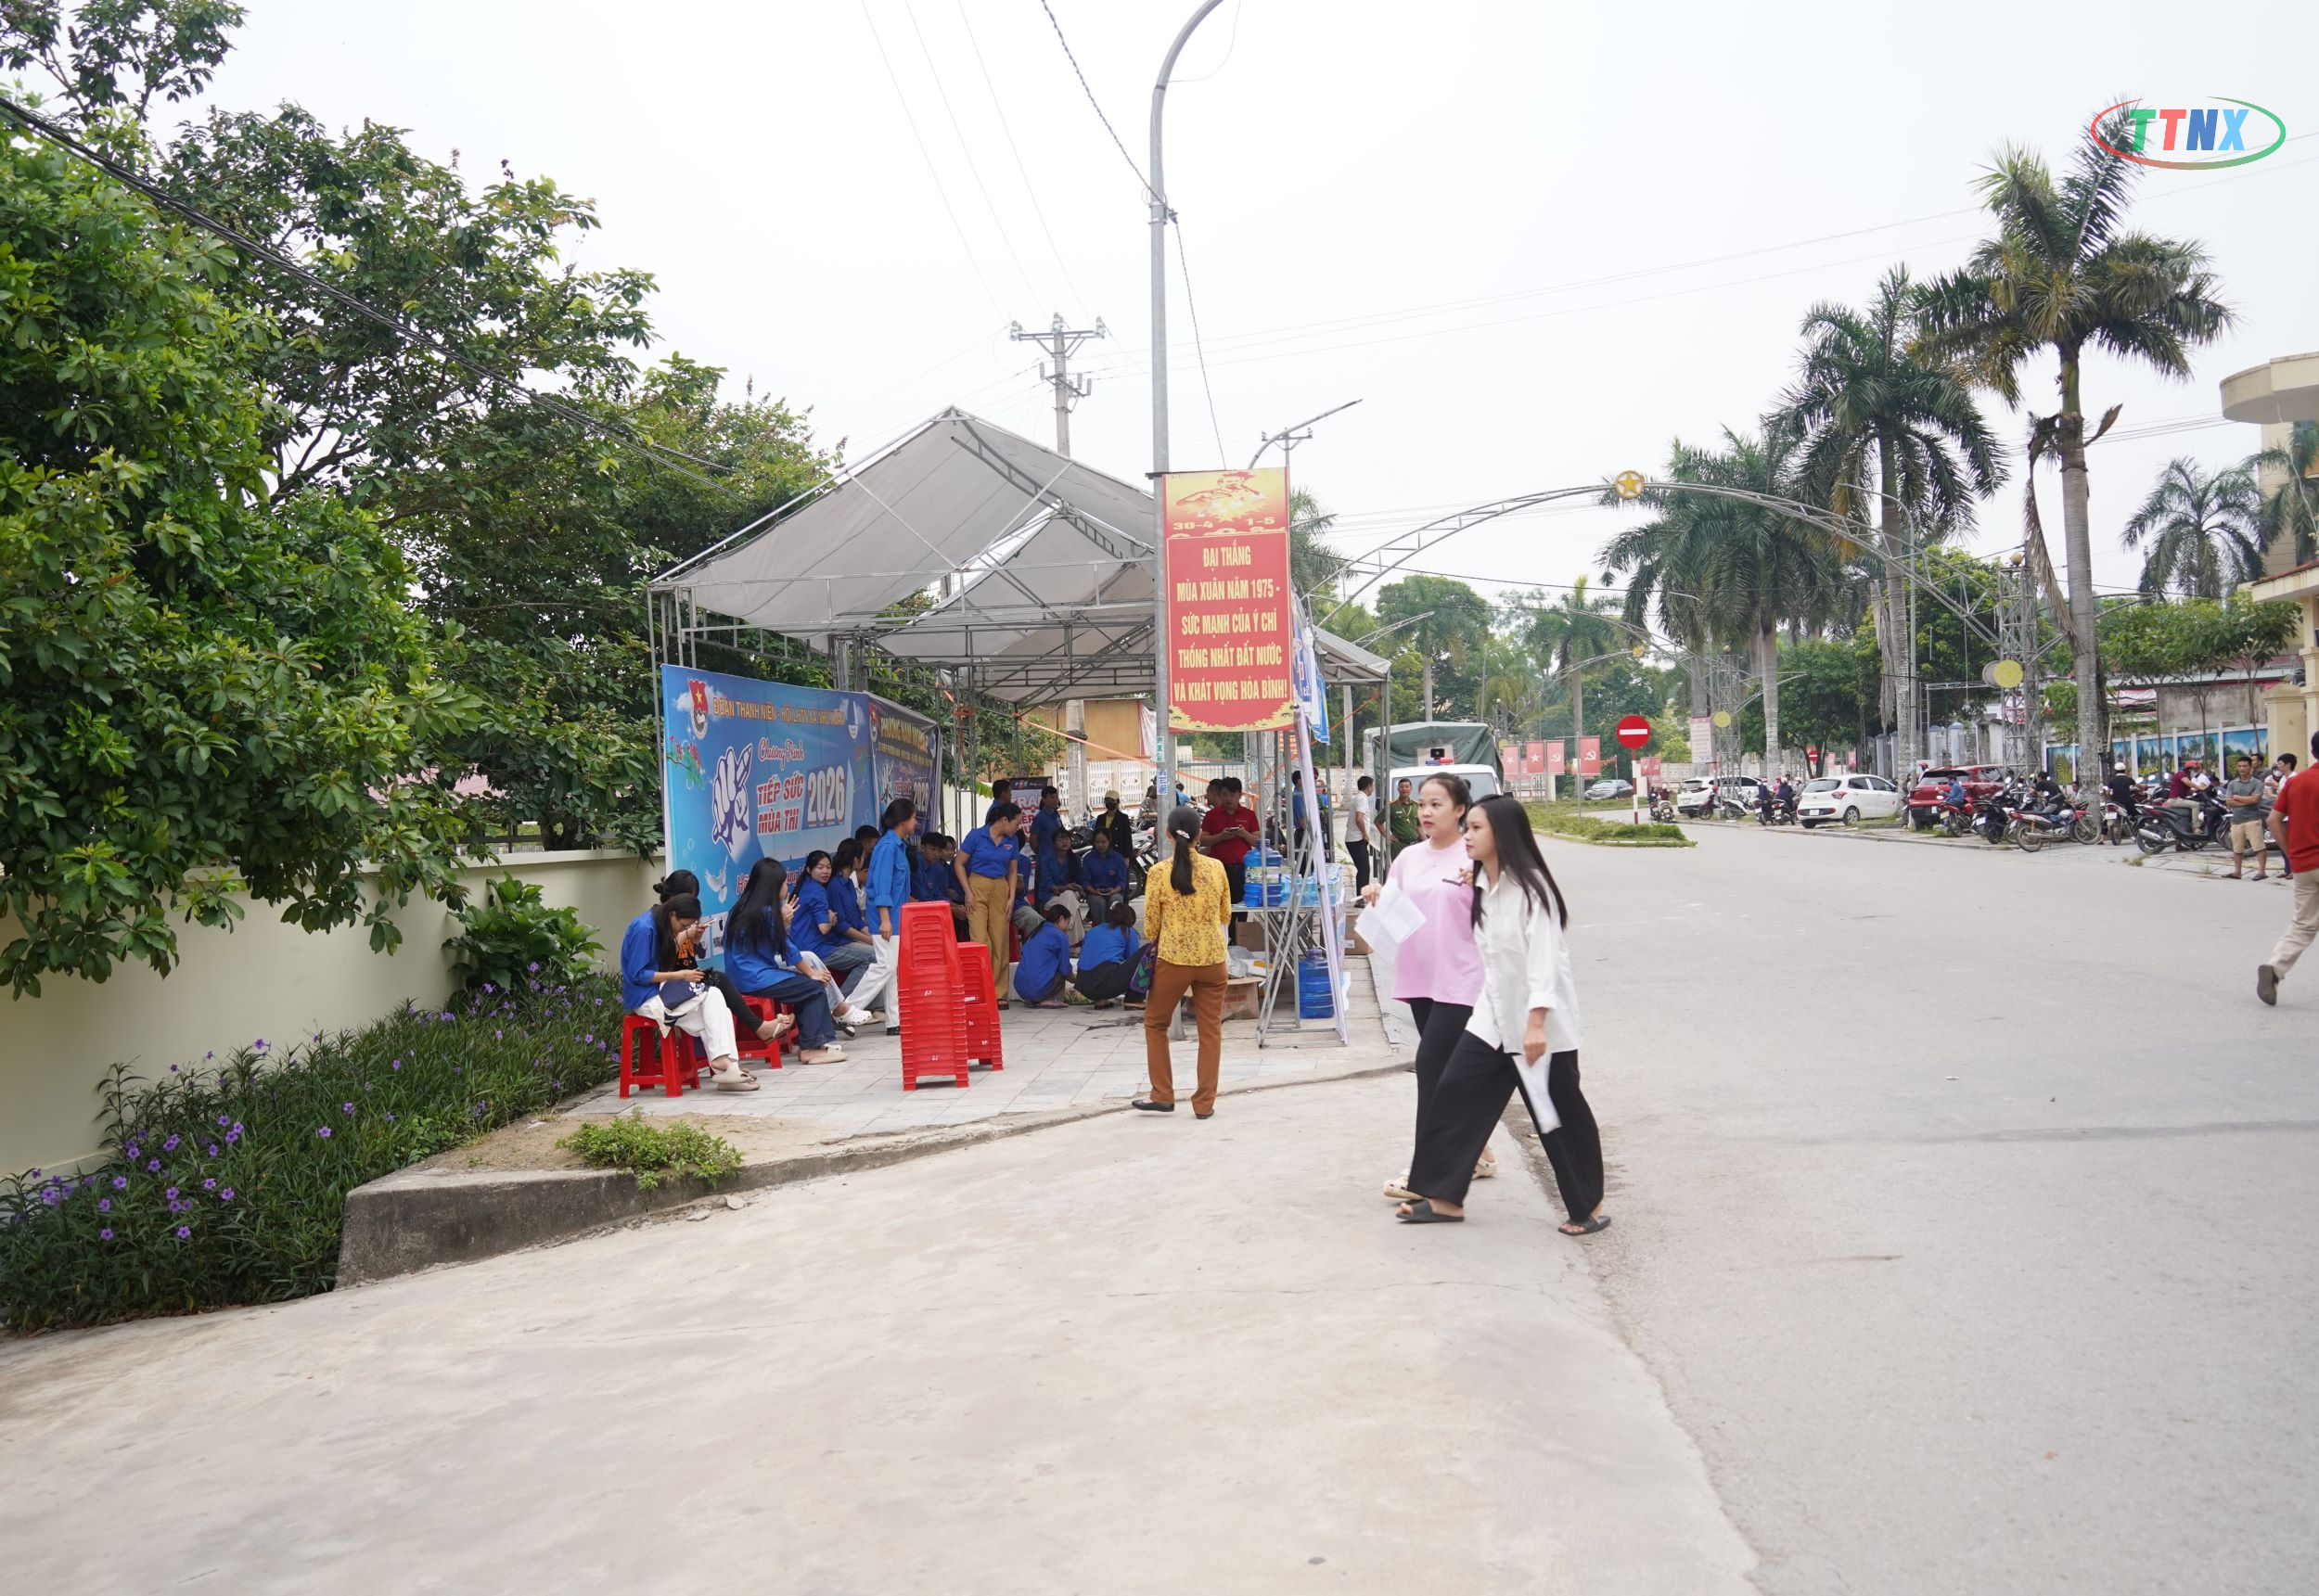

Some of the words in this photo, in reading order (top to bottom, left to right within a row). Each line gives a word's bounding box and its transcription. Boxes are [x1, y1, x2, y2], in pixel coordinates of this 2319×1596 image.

[1246, 517, 1275, 527] 1-5
[1203, 547, 1219, 571] ĐẠI
[1221, 539, 1251, 567] THẮNG
[1176, 579, 1198, 602] MÙA
[1199, 577, 1224, 601] XUÂN
[1227, 576, 1249, 600] NĂM
[1250, 579, 1274, 598] 1975
[1182, 609, 1200, 635] SỨC
[1202, 614, 1230, 638] MẠNH
[1232, 606, 1251, 633] CỦA
[1253, 606, 1260, 632] Ý
[1262, 608, 1277, 632] CHÍ
[1178, 643, 1208, 668] THỐNG
[1211, 640, 1234, 668] NHẤT
[1236, 640, 1254, 667] ĐẤT
[1256, 641, 1282, 665] NƯỚC
[1174, 678, 1186, 702] VÀ
[1188, 677, 1211, 701] KHÁT
[1213, 682, 1237, 705] VỌNG
[1240, 675, 1260, 699] HÒA
[1262, 674, 1288, 699] BÌNH!
[712, 696, 735, 717] ĐOÀN
[736, 701, 760, 720] THANH
[761, 701, 776, 721] NIÊN
[757, 774, 781, 806] TIẾP
[783, 772, 804, 801] SỨC
[808, 765, 845, 825] 2026
[758, 808, 781, 834] MÙA
[784, 808, 800, 832] THI
